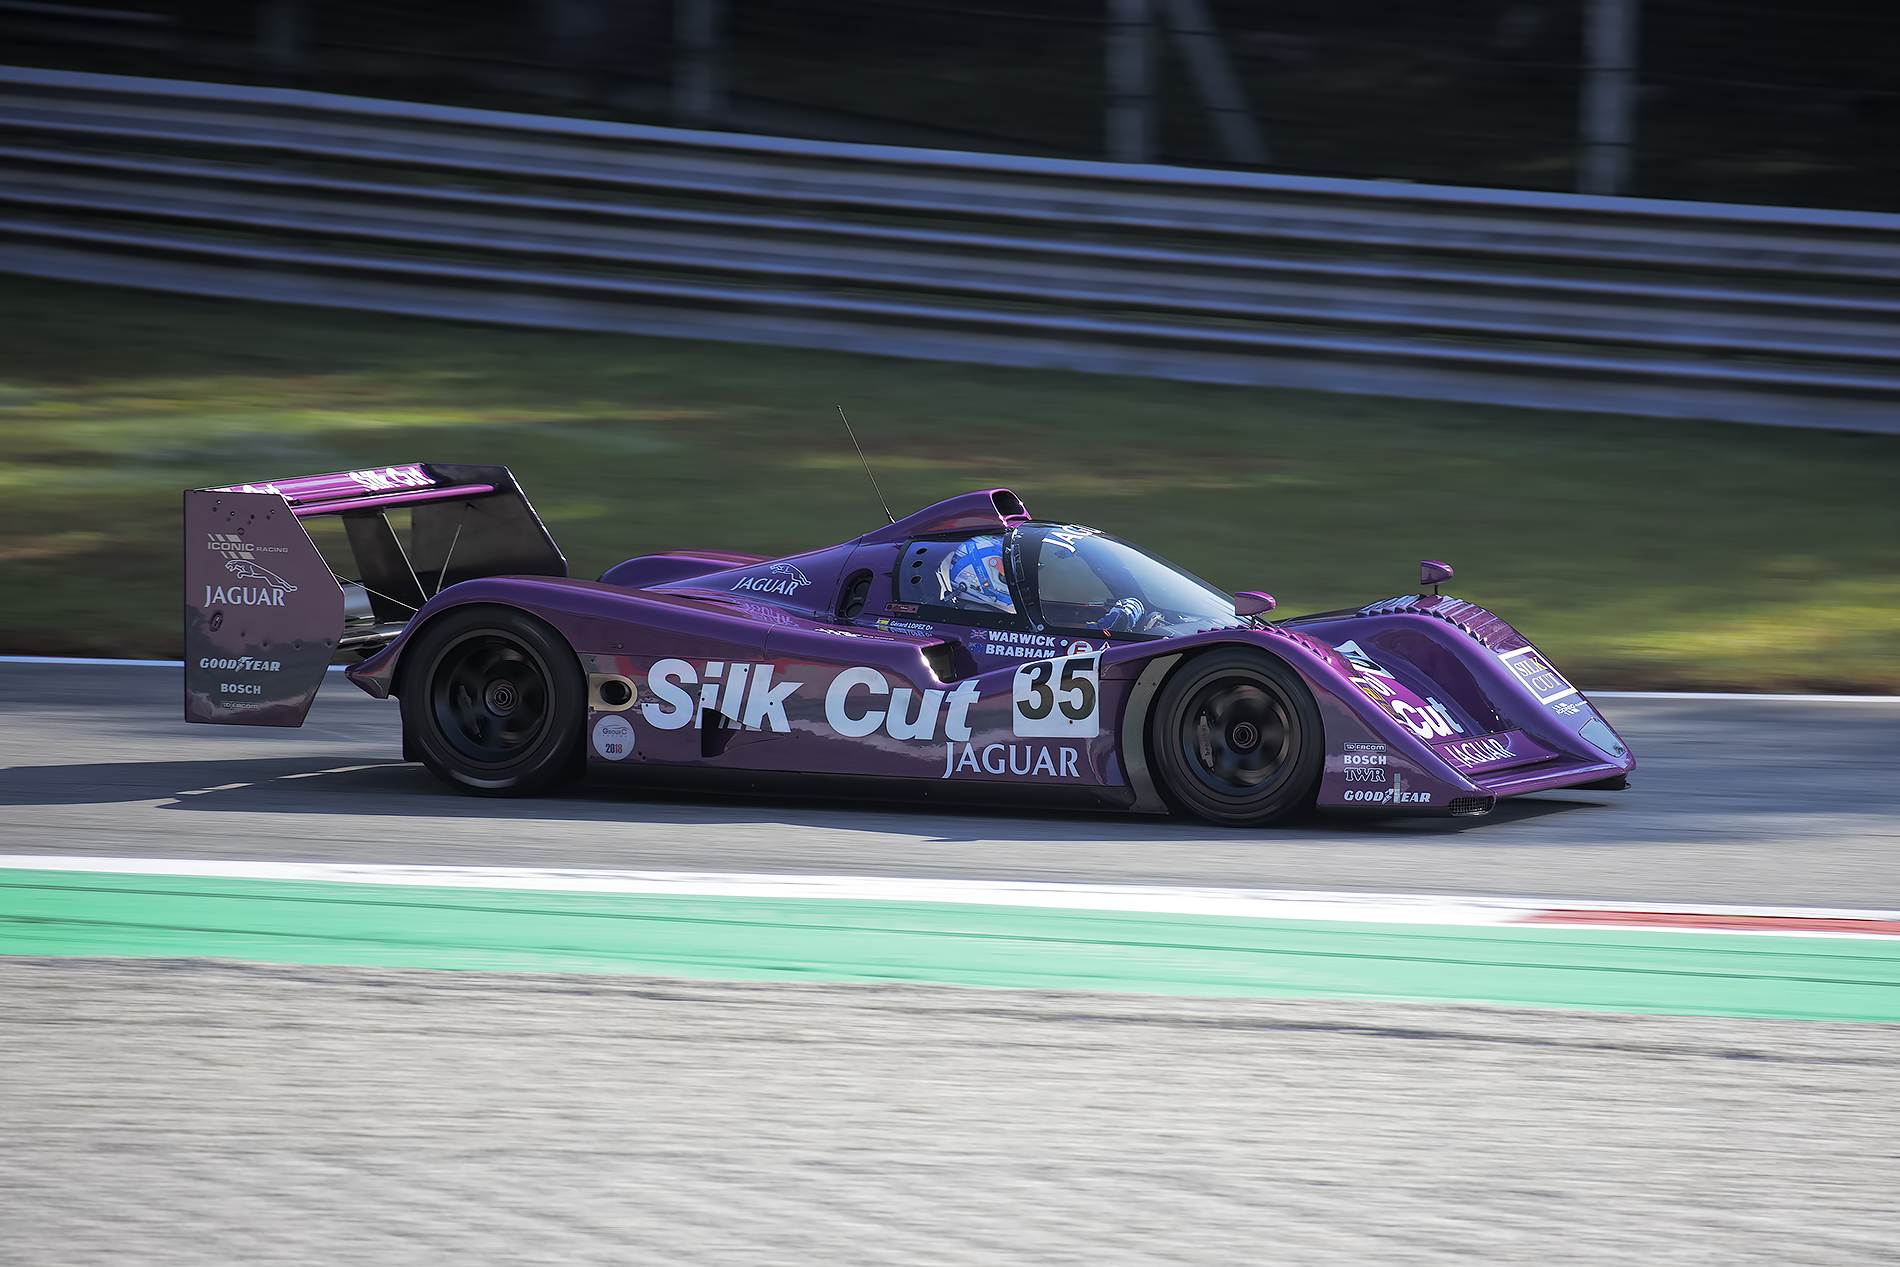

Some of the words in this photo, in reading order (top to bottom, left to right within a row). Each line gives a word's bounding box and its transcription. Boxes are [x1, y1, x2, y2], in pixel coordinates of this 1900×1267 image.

[207, 541, 255, 552] ICONIC
[730, 576, 799, 596] JAGUAR
[203, 585, 286, 608] JAGUAR
[988, 630, 1056, 647] WARWICK
[985, 643, 1056, 659] BRABHAM
[200, 656, 281, 672] GOODYEAR
[1513, 656, 1549, 677] SILK
[220, 683, 262, 695] BOSCH
[1016, 658, 1097, 721] 35
[1531, 671, 1562, 692] CUT
[640, 657, 805, 733] Silk
[824, 666, 981, 742] Cut
[1390, 696, 1465, 739] Cut
[605, 743, 623, 754] 2018
[1443, 738, 1518, 769] JAGUAR
[942, 742, 1081, 779] JAGUAR
[1343, 754, 1387, 765] BOSCH
[1343, 766, 1387, 783] TWR
[1343, 788, 1432, 805] GOODEAR
